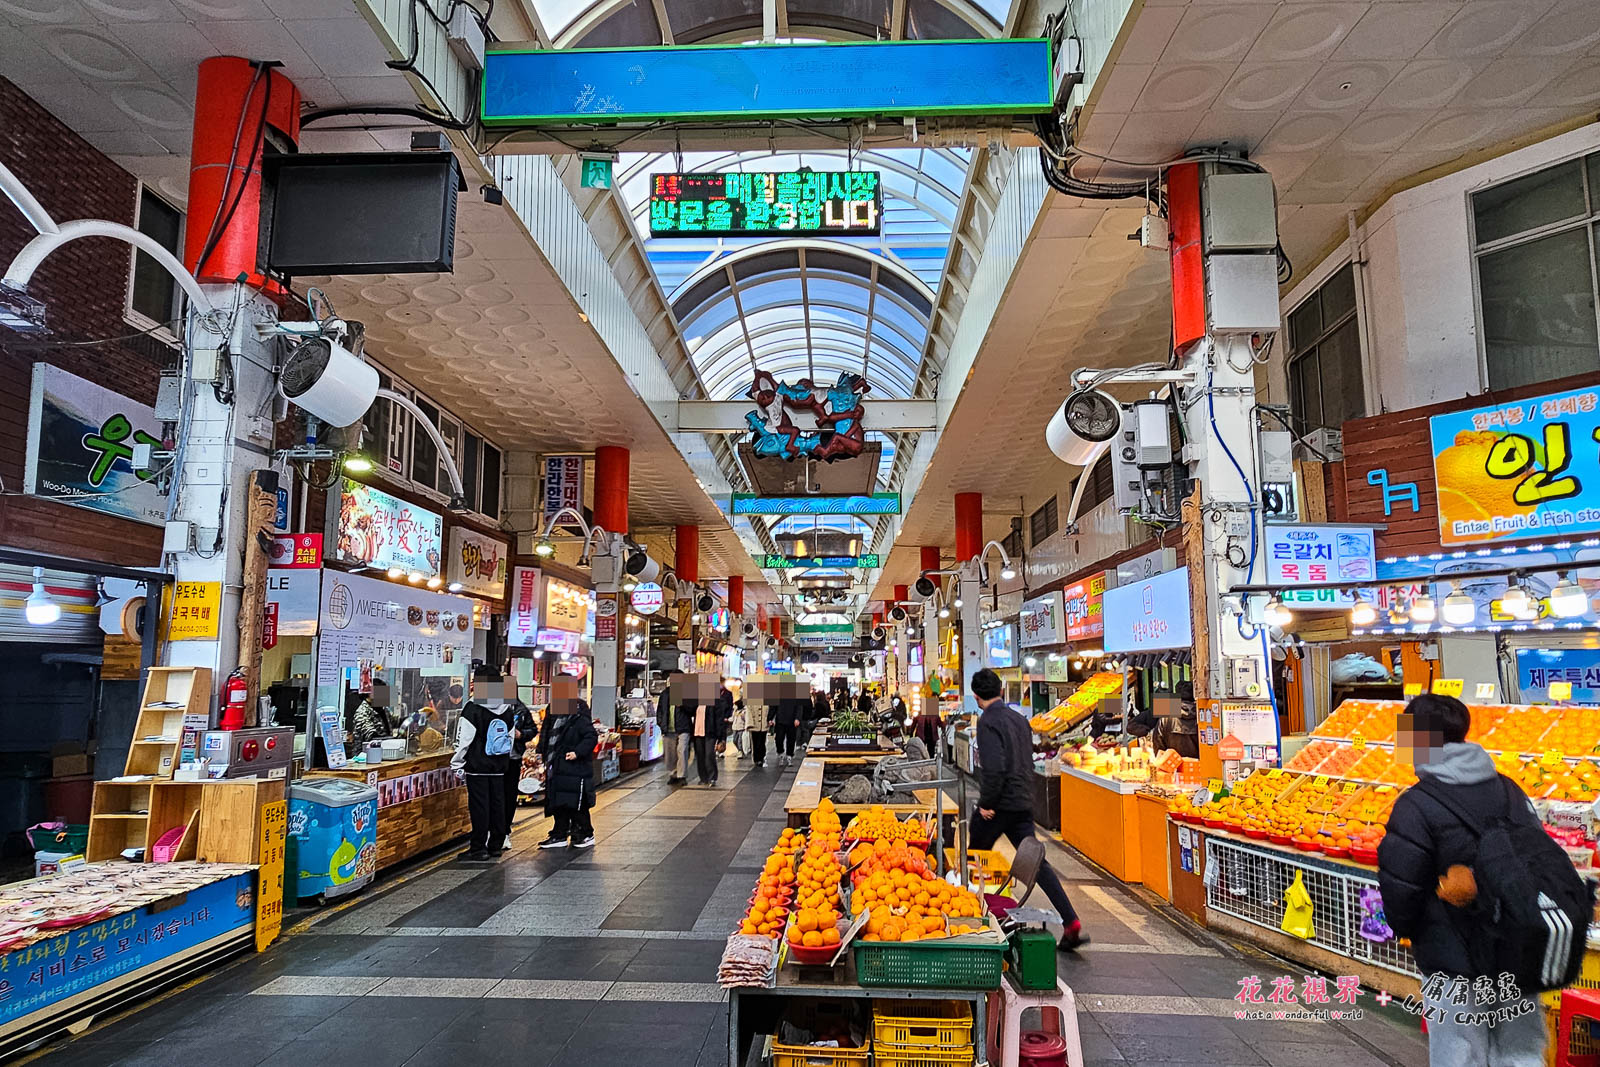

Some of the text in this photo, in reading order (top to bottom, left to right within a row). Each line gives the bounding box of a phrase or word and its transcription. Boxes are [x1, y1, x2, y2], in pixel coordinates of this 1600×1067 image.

[651, 201, 733, 230] 방문을
[1472, 408, 1524, 430] 한라봉
[1485, 421, 1600, 507] 인
[1455, 508, 1600, 535] Entae Fruit & Fish sto
[1274, 543, 1332, 560] 은갈치
[1281, 564, 1327, 581] 옥 돔
[264, 617, 275, 645] 소화기
[26, 946, 107, 986] 서비스로
